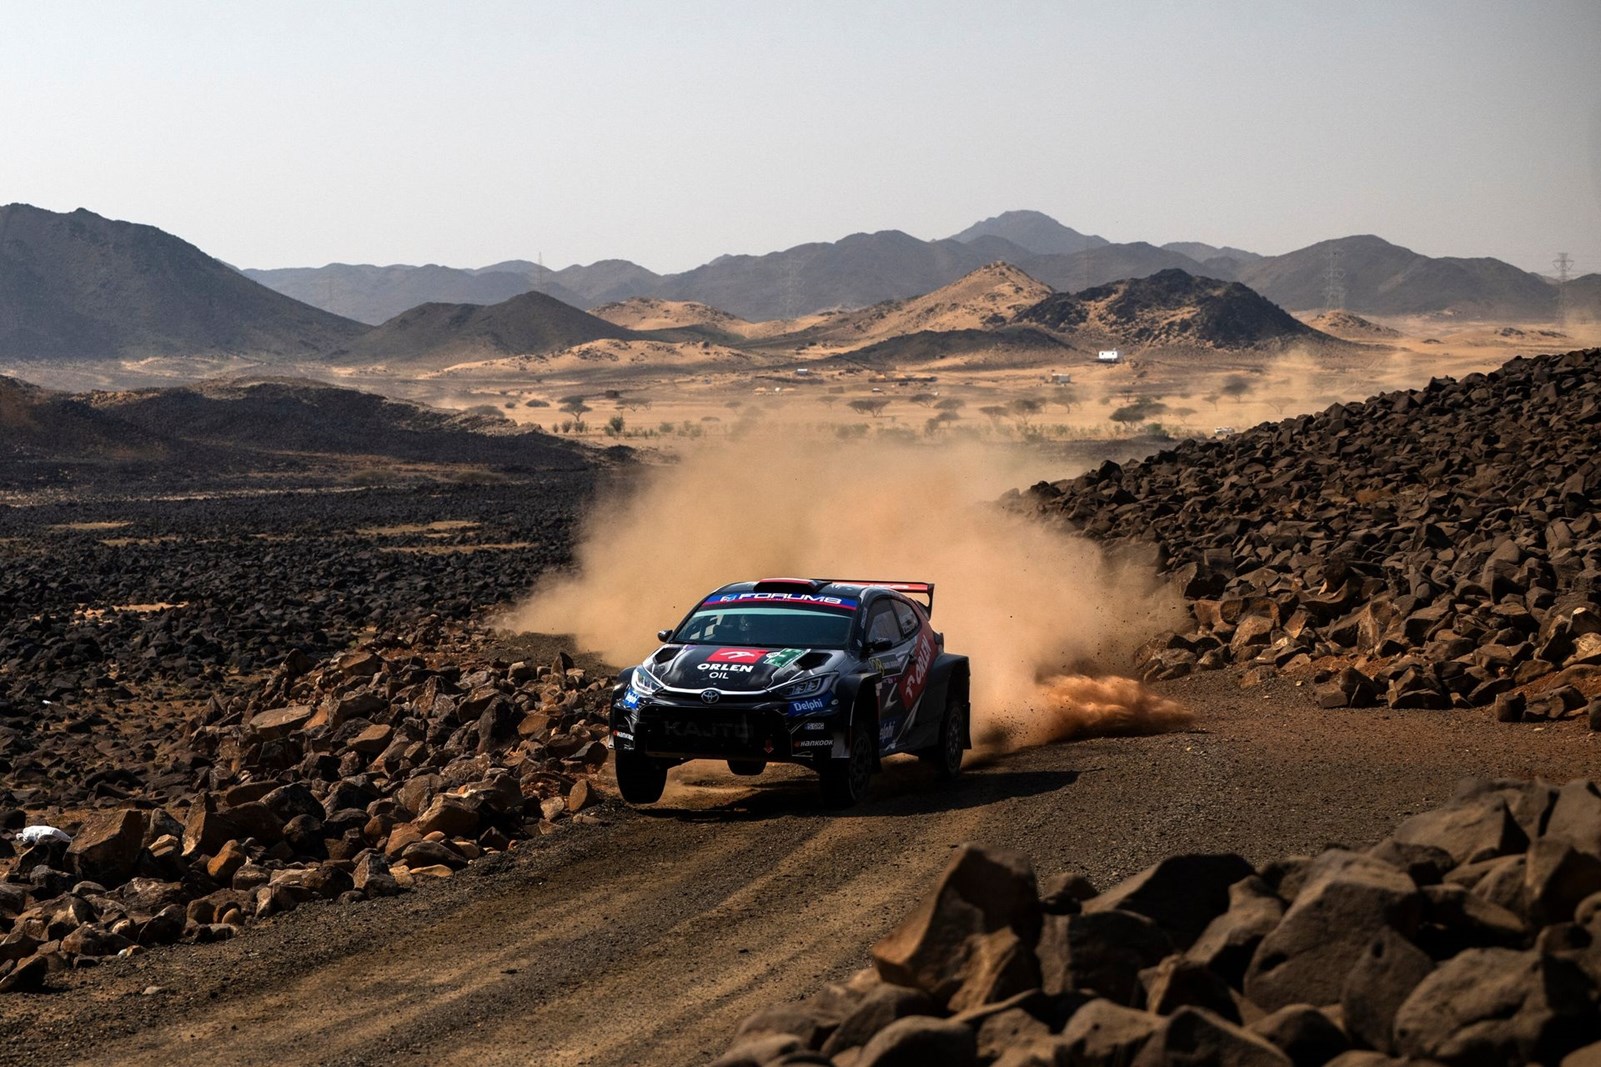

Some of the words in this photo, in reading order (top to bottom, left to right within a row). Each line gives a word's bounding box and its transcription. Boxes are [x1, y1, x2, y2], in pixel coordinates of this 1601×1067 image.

[738, 592, 842, 604] FORUM8
[697, 663, 754, 673] ORLEN
[709, 672, 729, 680] OIL
[793, 698, 824, 712] Delphi
